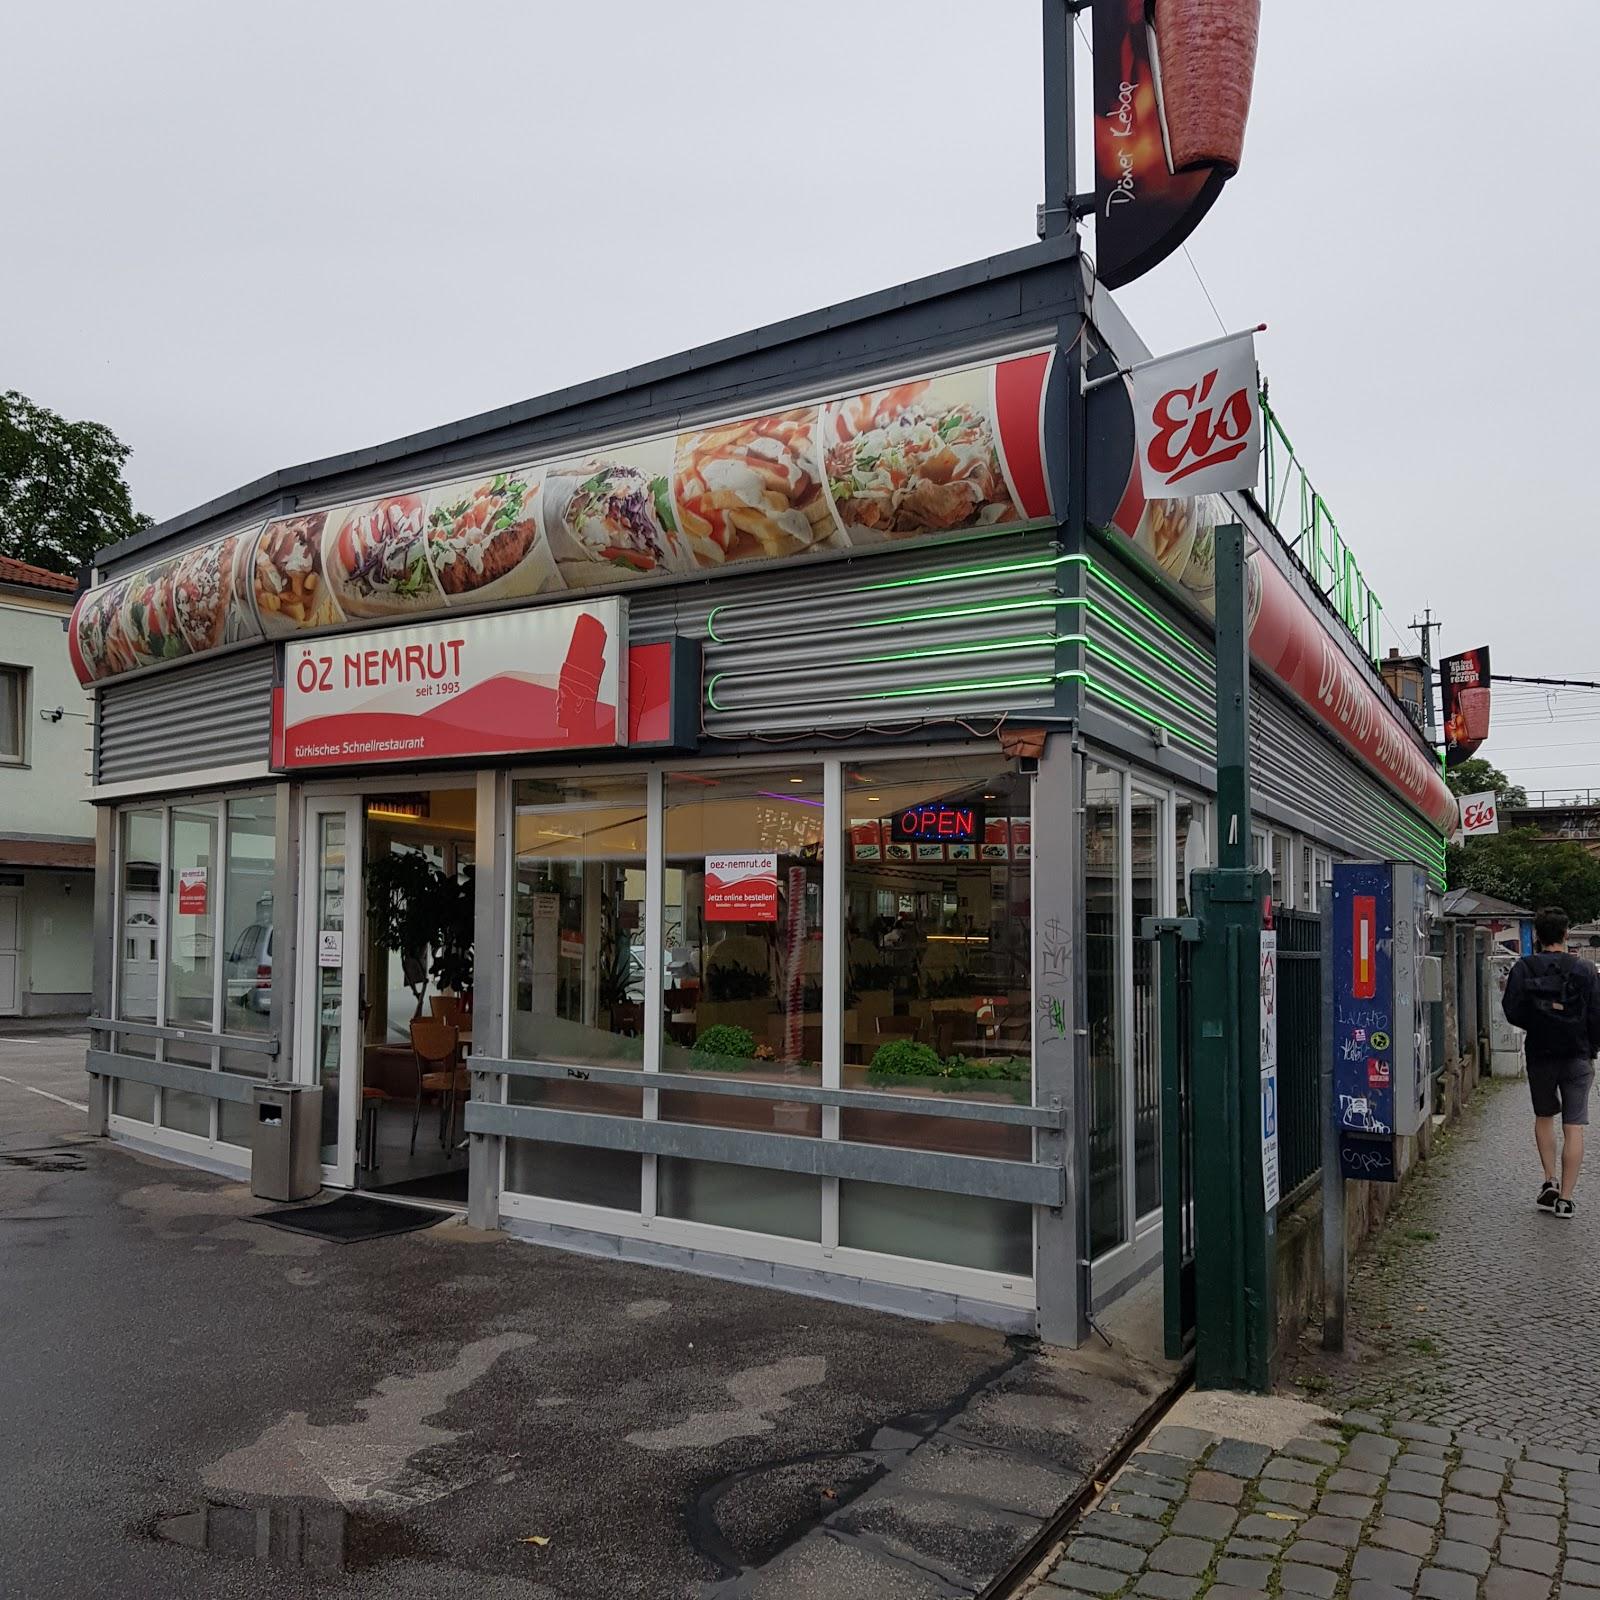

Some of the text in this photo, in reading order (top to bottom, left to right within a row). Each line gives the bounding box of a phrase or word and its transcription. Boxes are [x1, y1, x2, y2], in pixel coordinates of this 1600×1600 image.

[1105, 81, 1139, 217] Döner Kebap
[1147, 368, 1252, 473] Eis
[297, 639, 465, 693] ÖZ NEMRUT
[415, 681, 461, 698] seit 1993
[1450, 673, 1480, 684] rezept
[295, 736, 425, 758] türkisches Schnellrestaurant
[901, 811, 974, 835] OPEN
[1464, 801, 1494, 828] Eis
[710, 859, 772, 870] oez-nemrut.de
[707, 893, 775, 902] Jetzt online bestellen!
